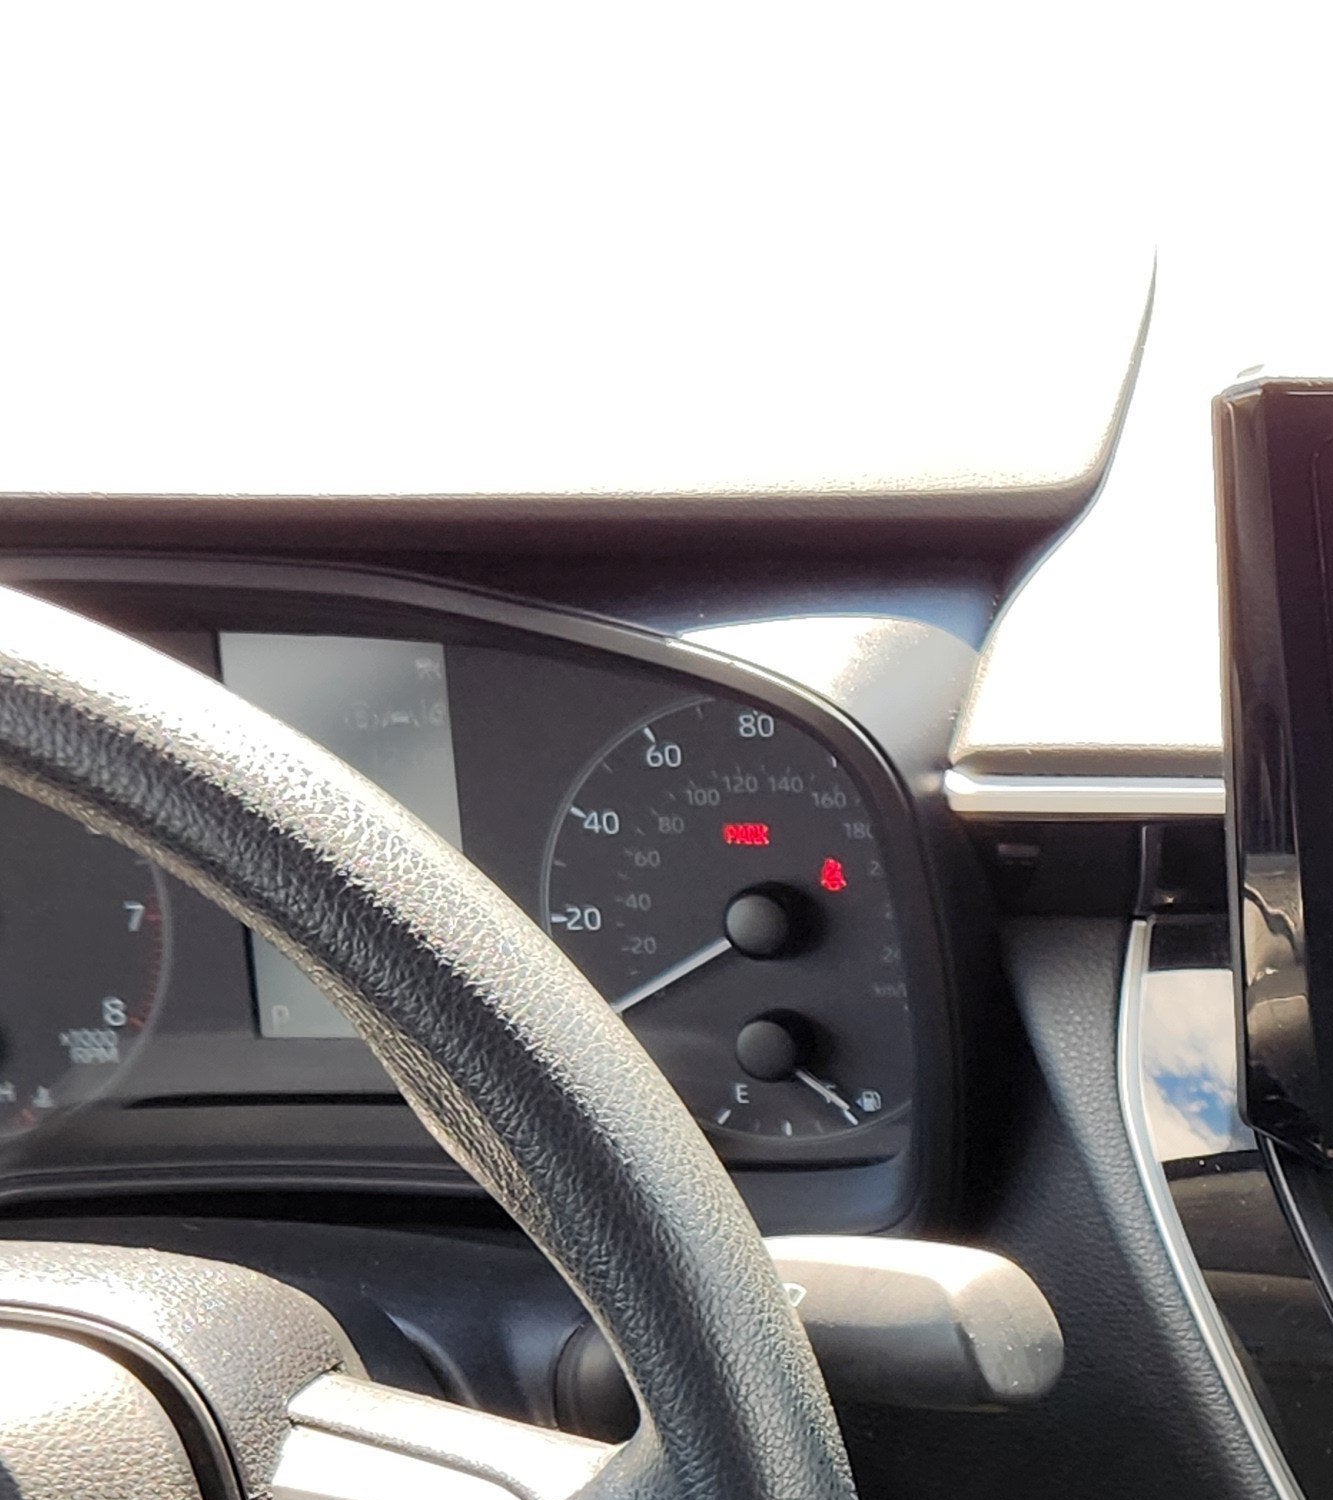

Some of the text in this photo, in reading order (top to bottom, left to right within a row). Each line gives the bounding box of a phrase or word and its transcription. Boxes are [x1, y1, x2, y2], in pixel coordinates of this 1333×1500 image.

[738, 713, 775, 738] 80
[646, 744, 682, 768] 60
[723, 775, 758, 793] 120
[768, 775, 804, 793] 140
[686, 788, 721, 806] 100
[811, 791, 847, 809] 160
[583, 811, 620, 835] 40
[634, 850, 661, 868] 60
[123, 900, 146, 931] 7
[565, 907, 602, 931] 20
[102, 996, 127, 1026] 8
[735, 1084, 749, 1104] E
